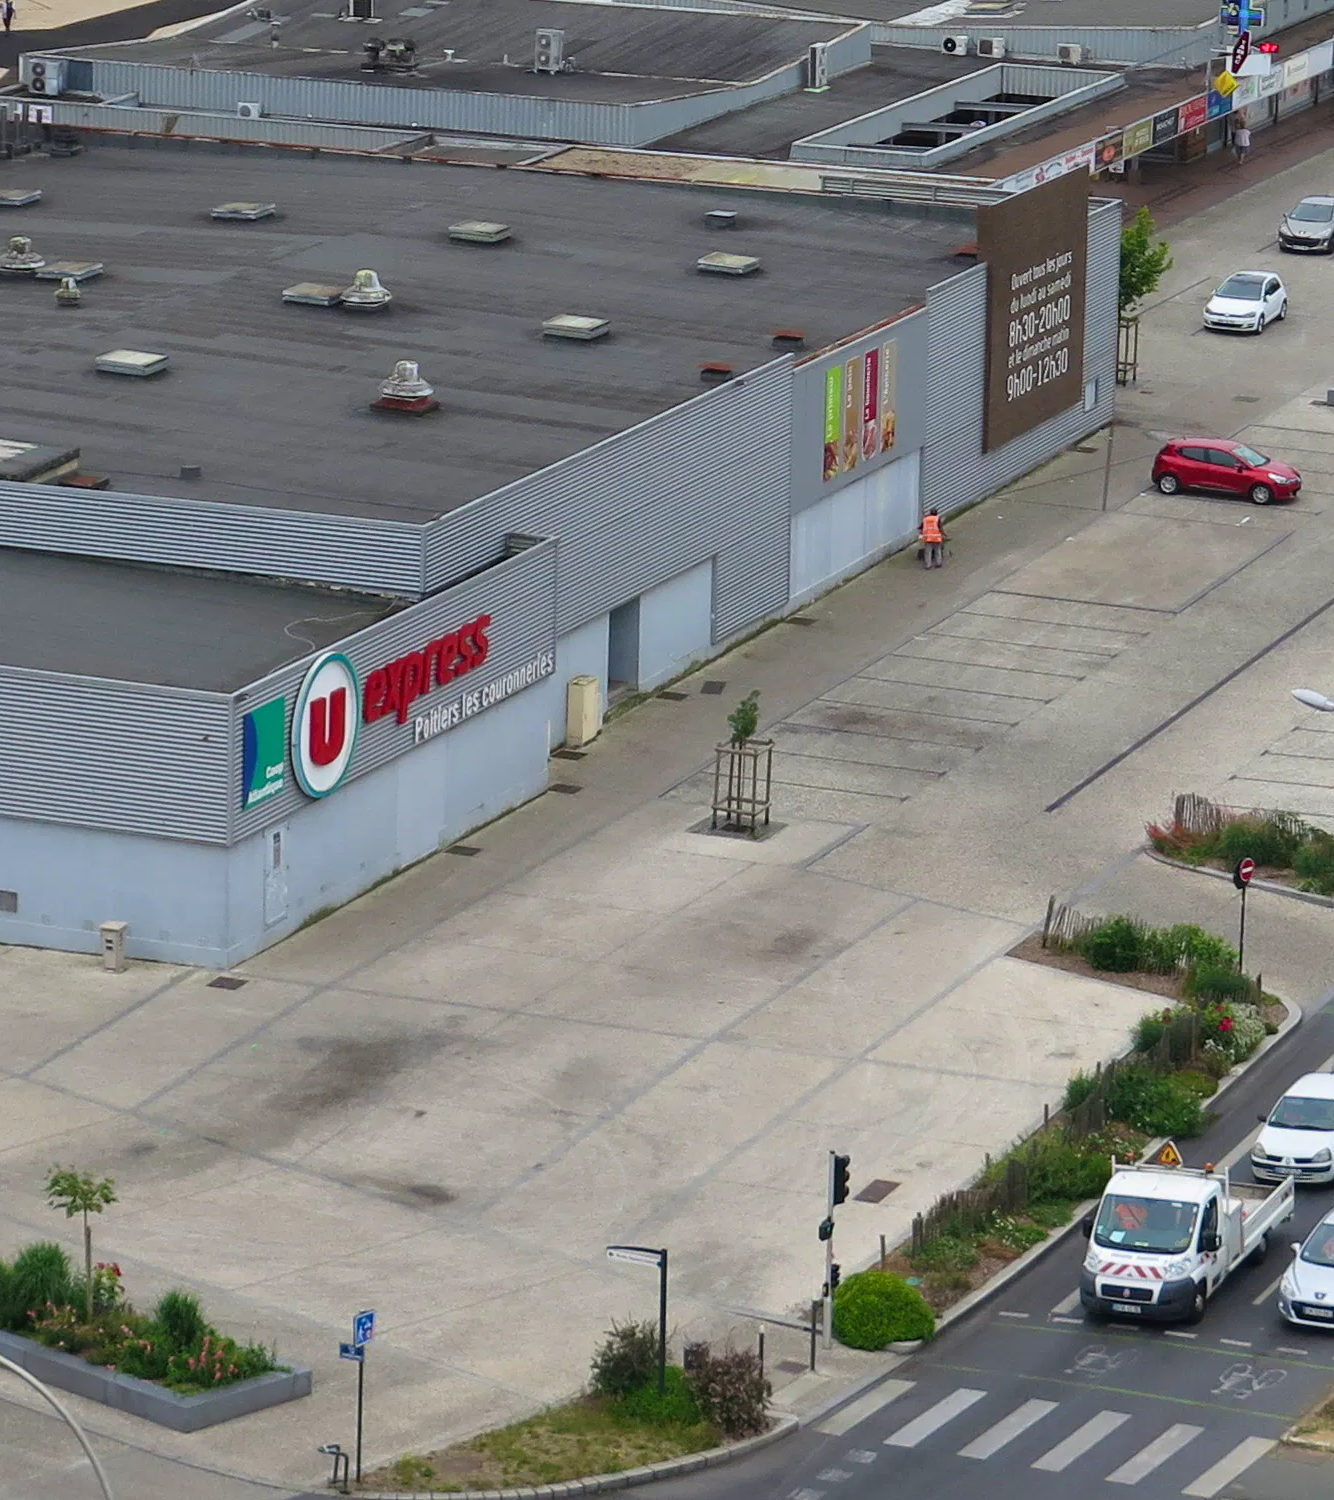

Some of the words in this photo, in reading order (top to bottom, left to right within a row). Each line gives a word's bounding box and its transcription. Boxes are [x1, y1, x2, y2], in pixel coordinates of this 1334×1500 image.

[1011, 268, 1033, 291] Ouvert
[1046, 257, 1056, 274] les
[1055, 251, 1073, 273] jours
[1037, 286, 1046, 301] au
[1047, 271, 1072, 296] samedi
[1008, 294, 1071, 348] 8h30-20h00
[1022, 335, 1052, 361] dimanche
[1006, 347, 1069, 402] 9h00-12h30
[309, 686, 347, 767] U
[363, 614, 492, 725] express
[414, 703, 460, 745] Poitiers
[462, 691, 480, 718] les
[482, 651, 554, 707] couronneries
